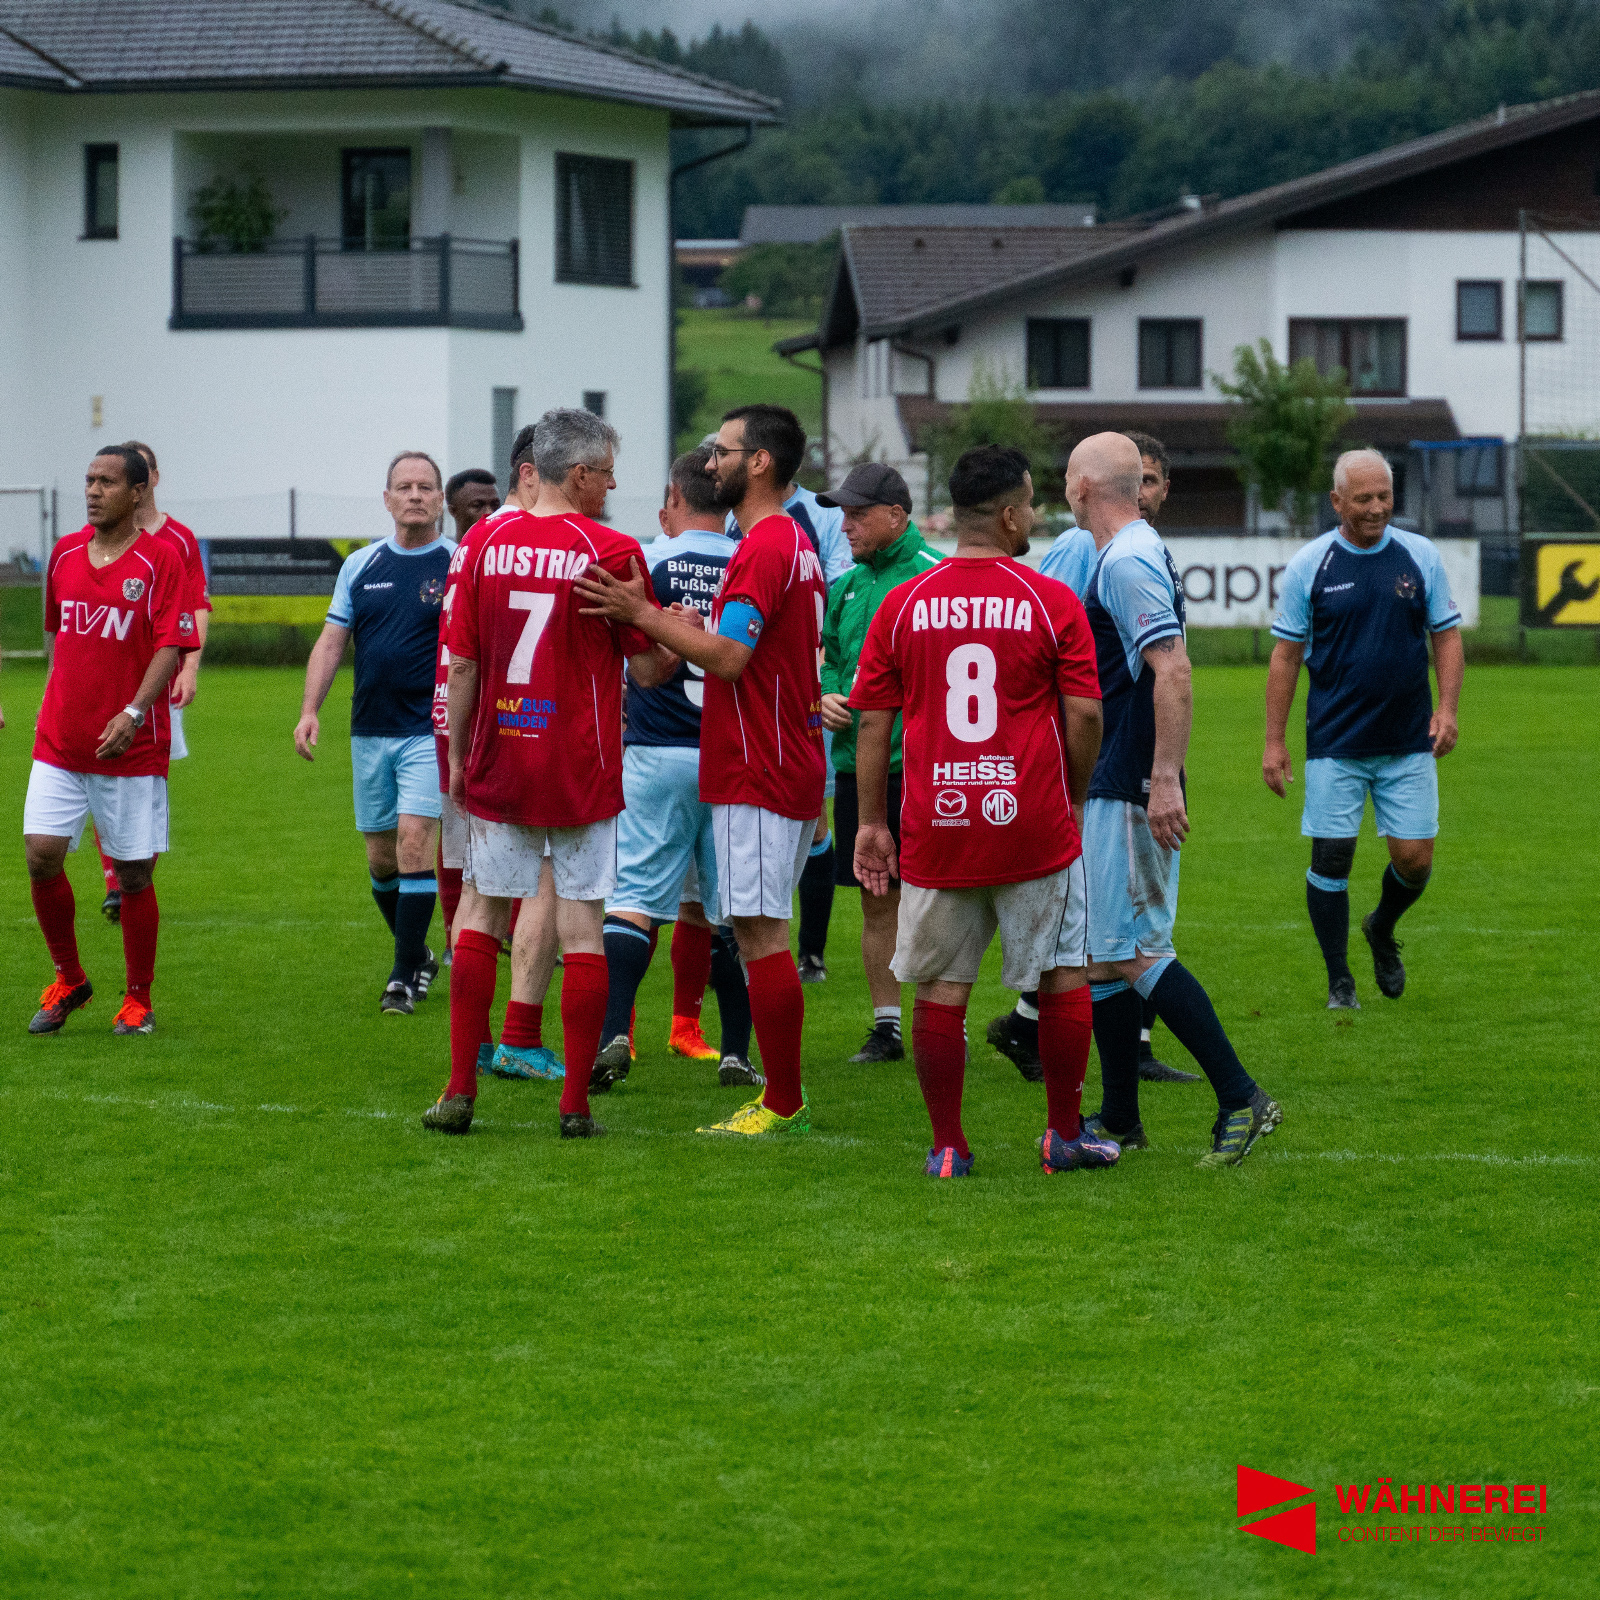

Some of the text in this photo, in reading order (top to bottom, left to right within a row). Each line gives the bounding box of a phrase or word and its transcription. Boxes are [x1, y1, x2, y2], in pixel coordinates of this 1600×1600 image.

[484, 544, 589, 580] AUSTRIA
[363, 582, 393, 590] SHARP
[1323, 582, 1355, 593] SHARP
[61, 600, 134, 641] EVN
[912, 596, 1032, 632] AUSTRIA
[506, 590, 555, 685] 7
[946, 642, 998, 742] 8
[984, 792, 1014, 822] MG
